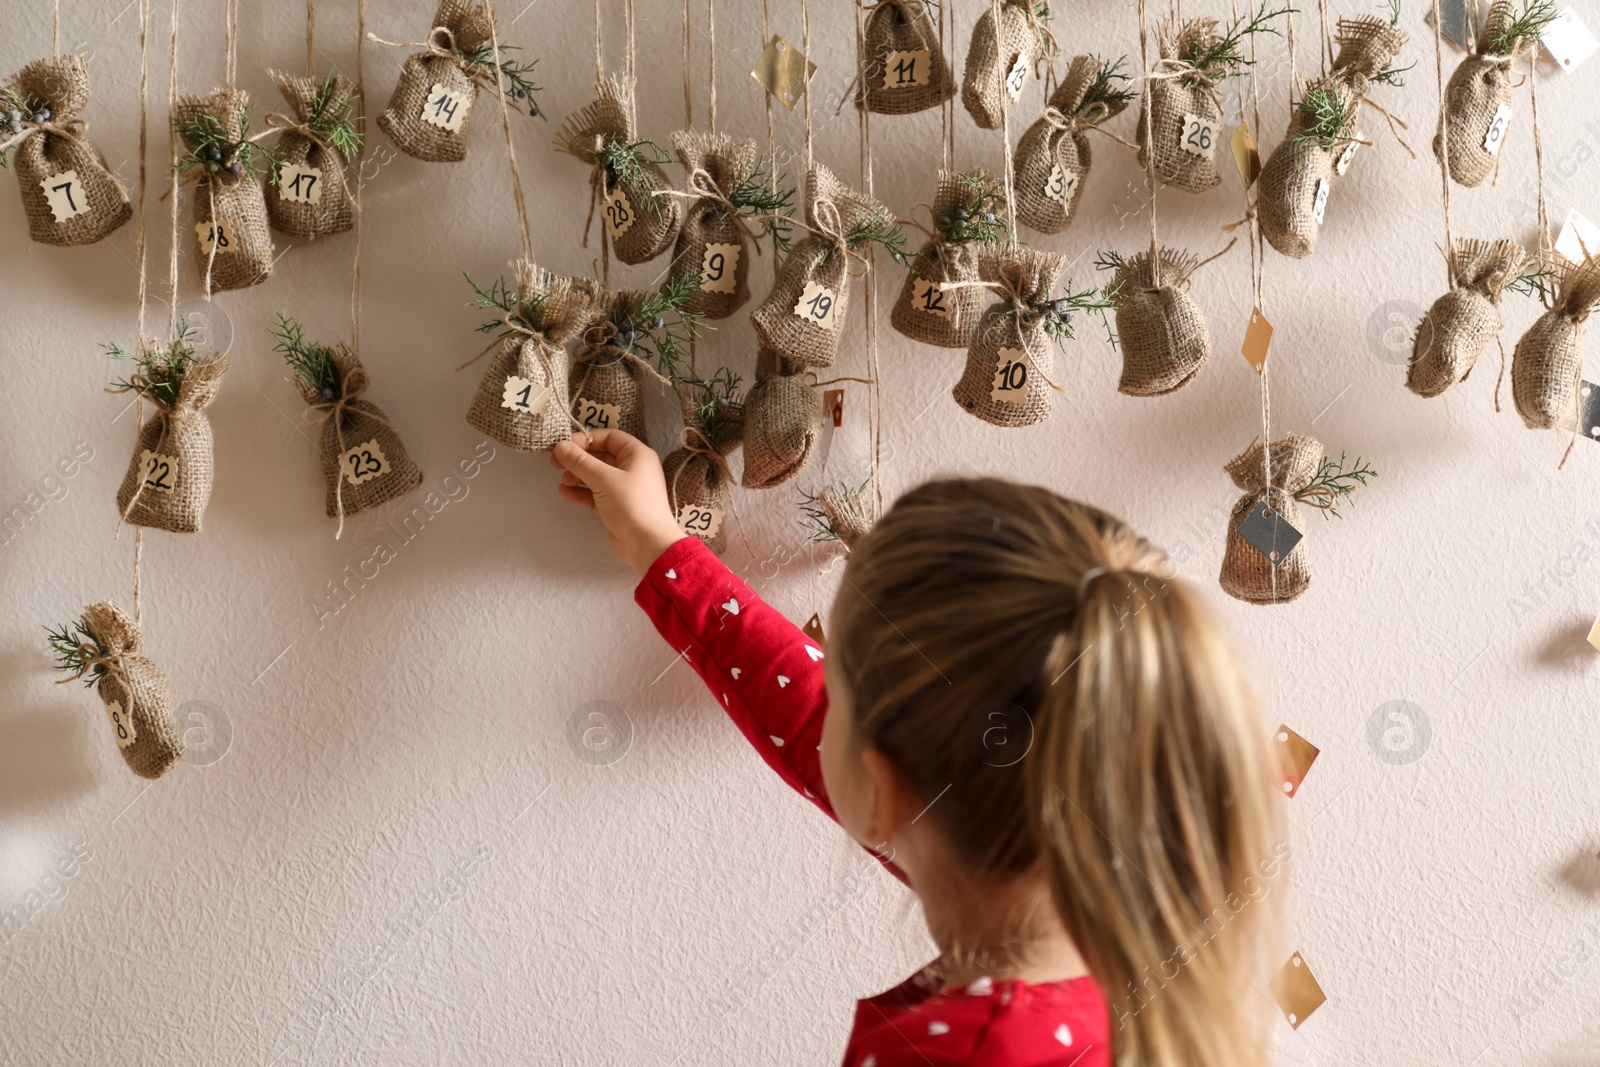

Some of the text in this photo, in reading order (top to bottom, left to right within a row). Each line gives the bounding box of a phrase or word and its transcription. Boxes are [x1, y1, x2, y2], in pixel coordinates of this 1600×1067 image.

[893, 57, 916, 84] 11
[432, 94, 459, 124] 14
[1187, 121, 1211, 150] 26
[1490, 117, 1504, 136] 6
[52, 181, 77, 212] 7
[288, 173, 317, 200] 17
[607, 199, 630, 230] 28
[706, 252, 725, 281] 9
[806, 292, 832, 320] 19
[920, 290, 946, 313] 12
[998, 359, 1027, 392] 10
[515, 385, 532, 408] 1
[583, 406, 610, 429] 24
[147, 458, 171, 489] 22
[349, 450, 381, 479] 23
[684, 509, 712, 532] 29
[112, 711, 128, 741] 8
